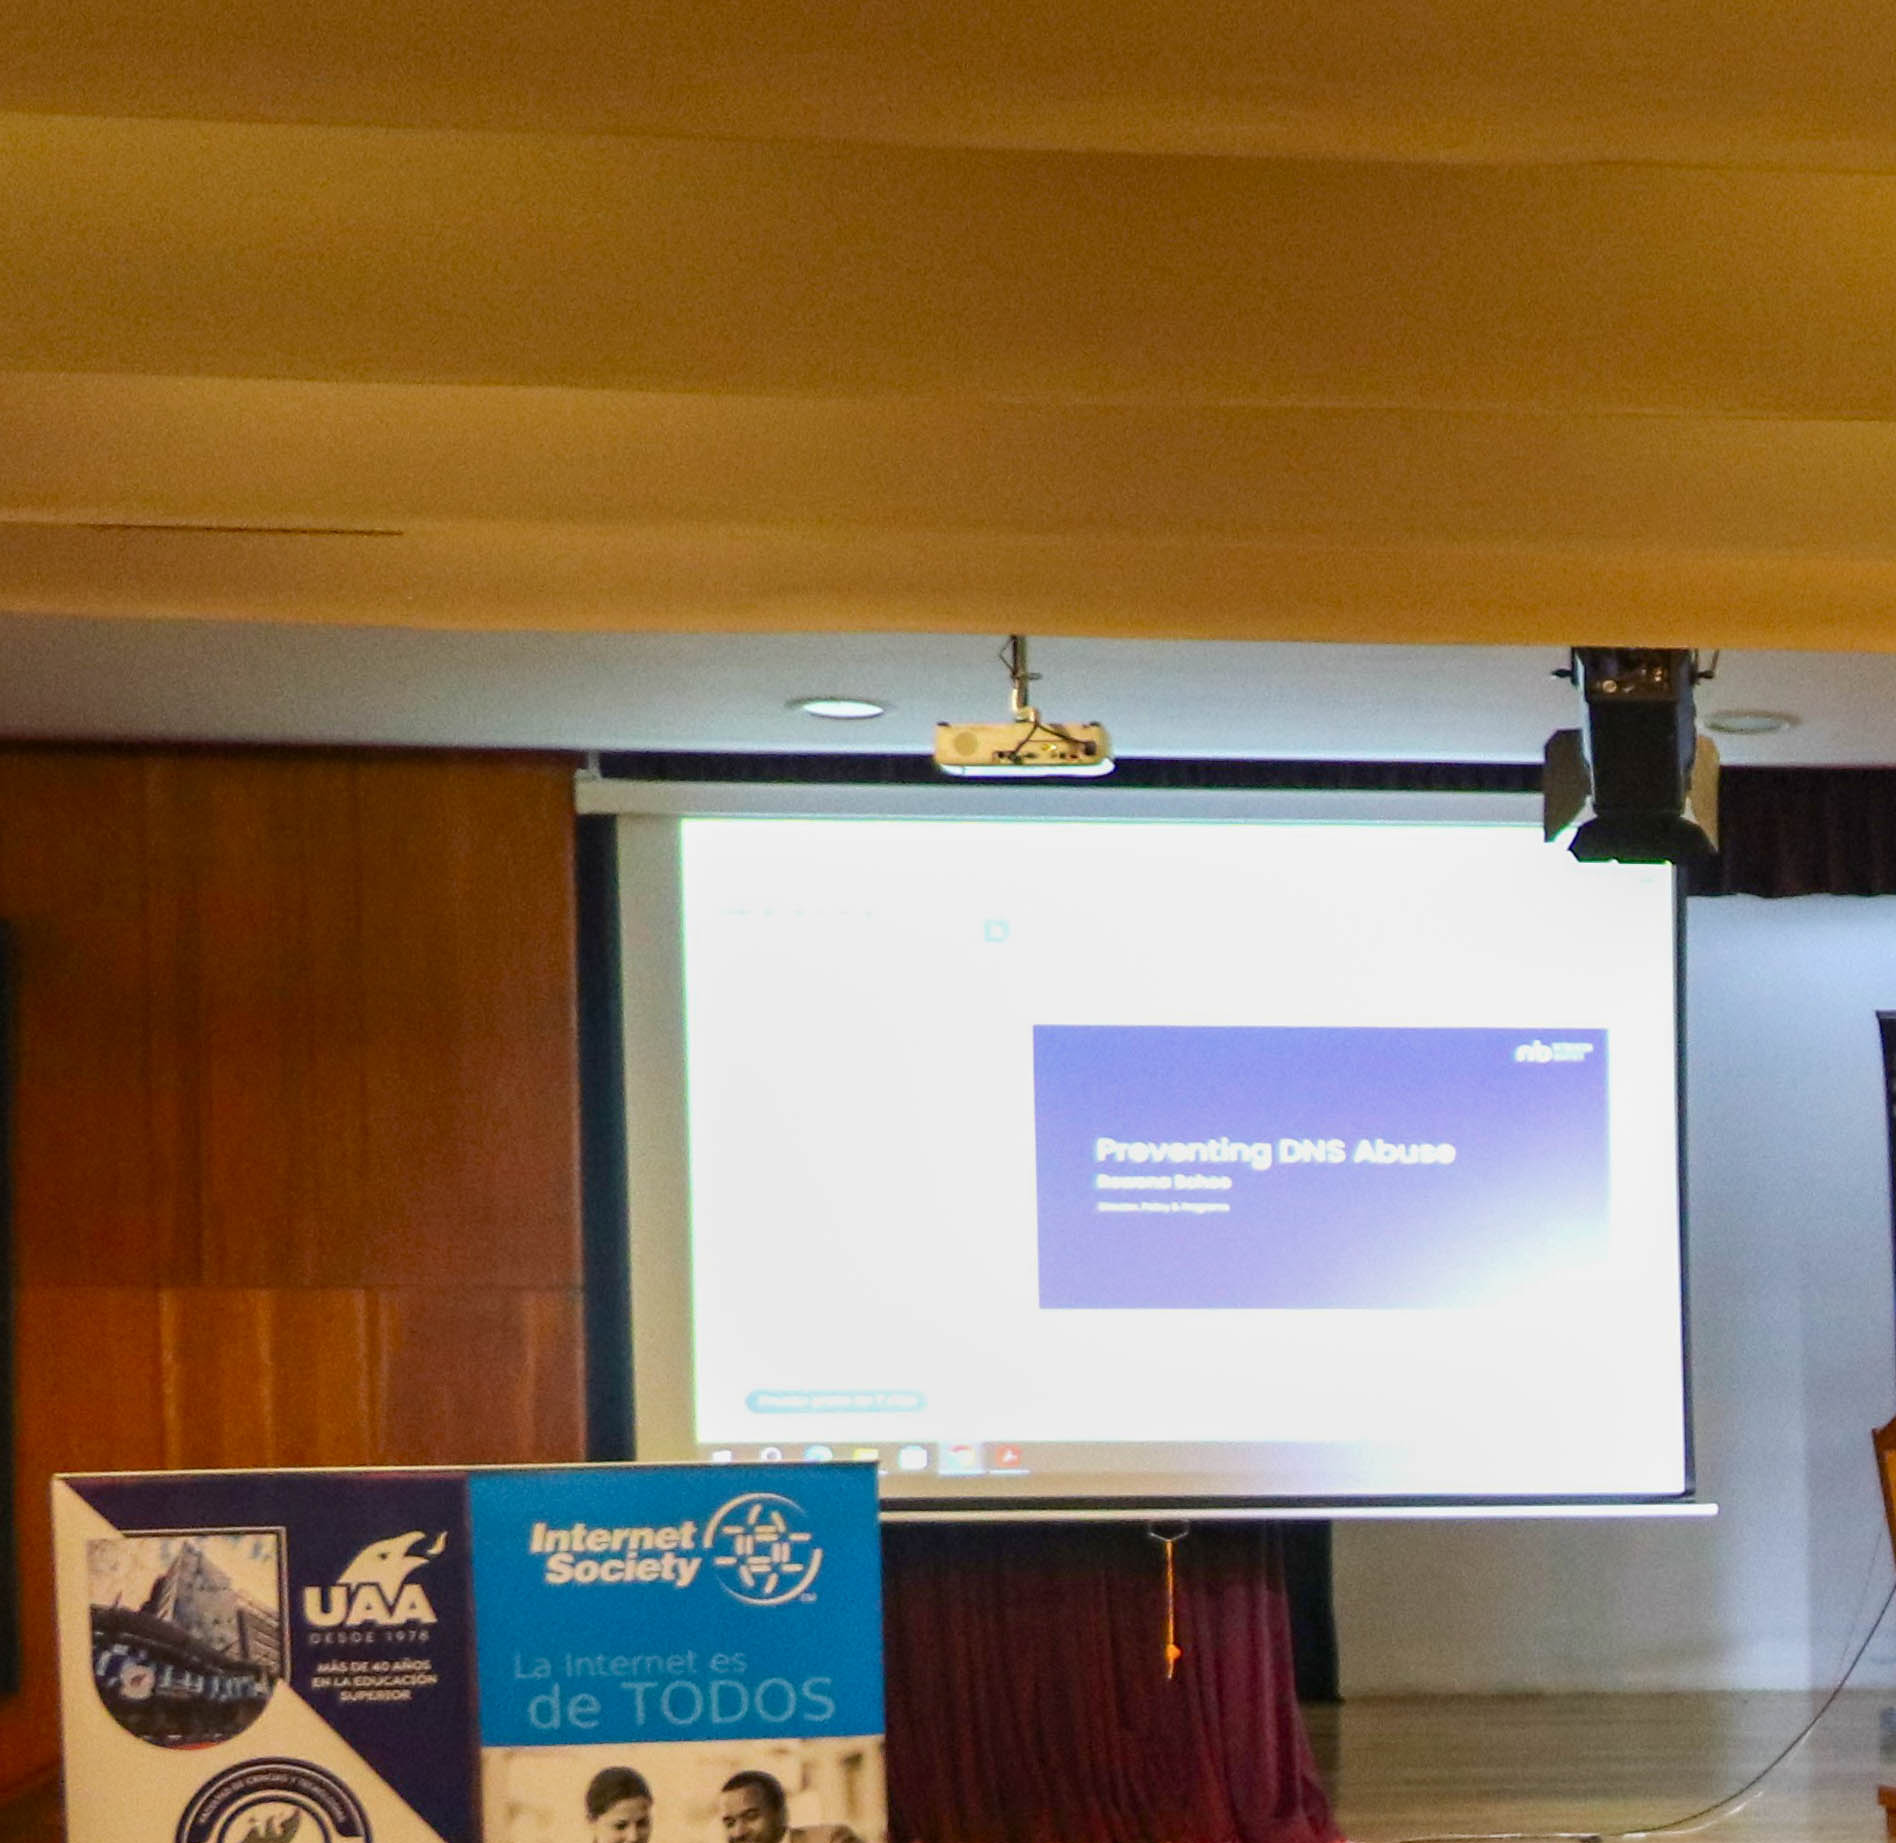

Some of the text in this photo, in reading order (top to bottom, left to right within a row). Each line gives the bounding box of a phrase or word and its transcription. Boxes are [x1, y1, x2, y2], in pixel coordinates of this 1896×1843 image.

[1095, 1136, 1457, 1170] Preventing DNS Abuse
[529, 1520, 697, 1553] Internet
[544, 1552, 703, 1589] Society
[303, 1582, 438, 1627] UAA
[309, 1630, 375, 1645] DESDE
[350, 1660, 369, 1673] DE
[513, 1650, 749, 1680] La Internet es
[311, 1677, 330, 1688] EN
[333, 1676, 349, 1687] LA
[528, 1676, 836, 1730] de TODOS
